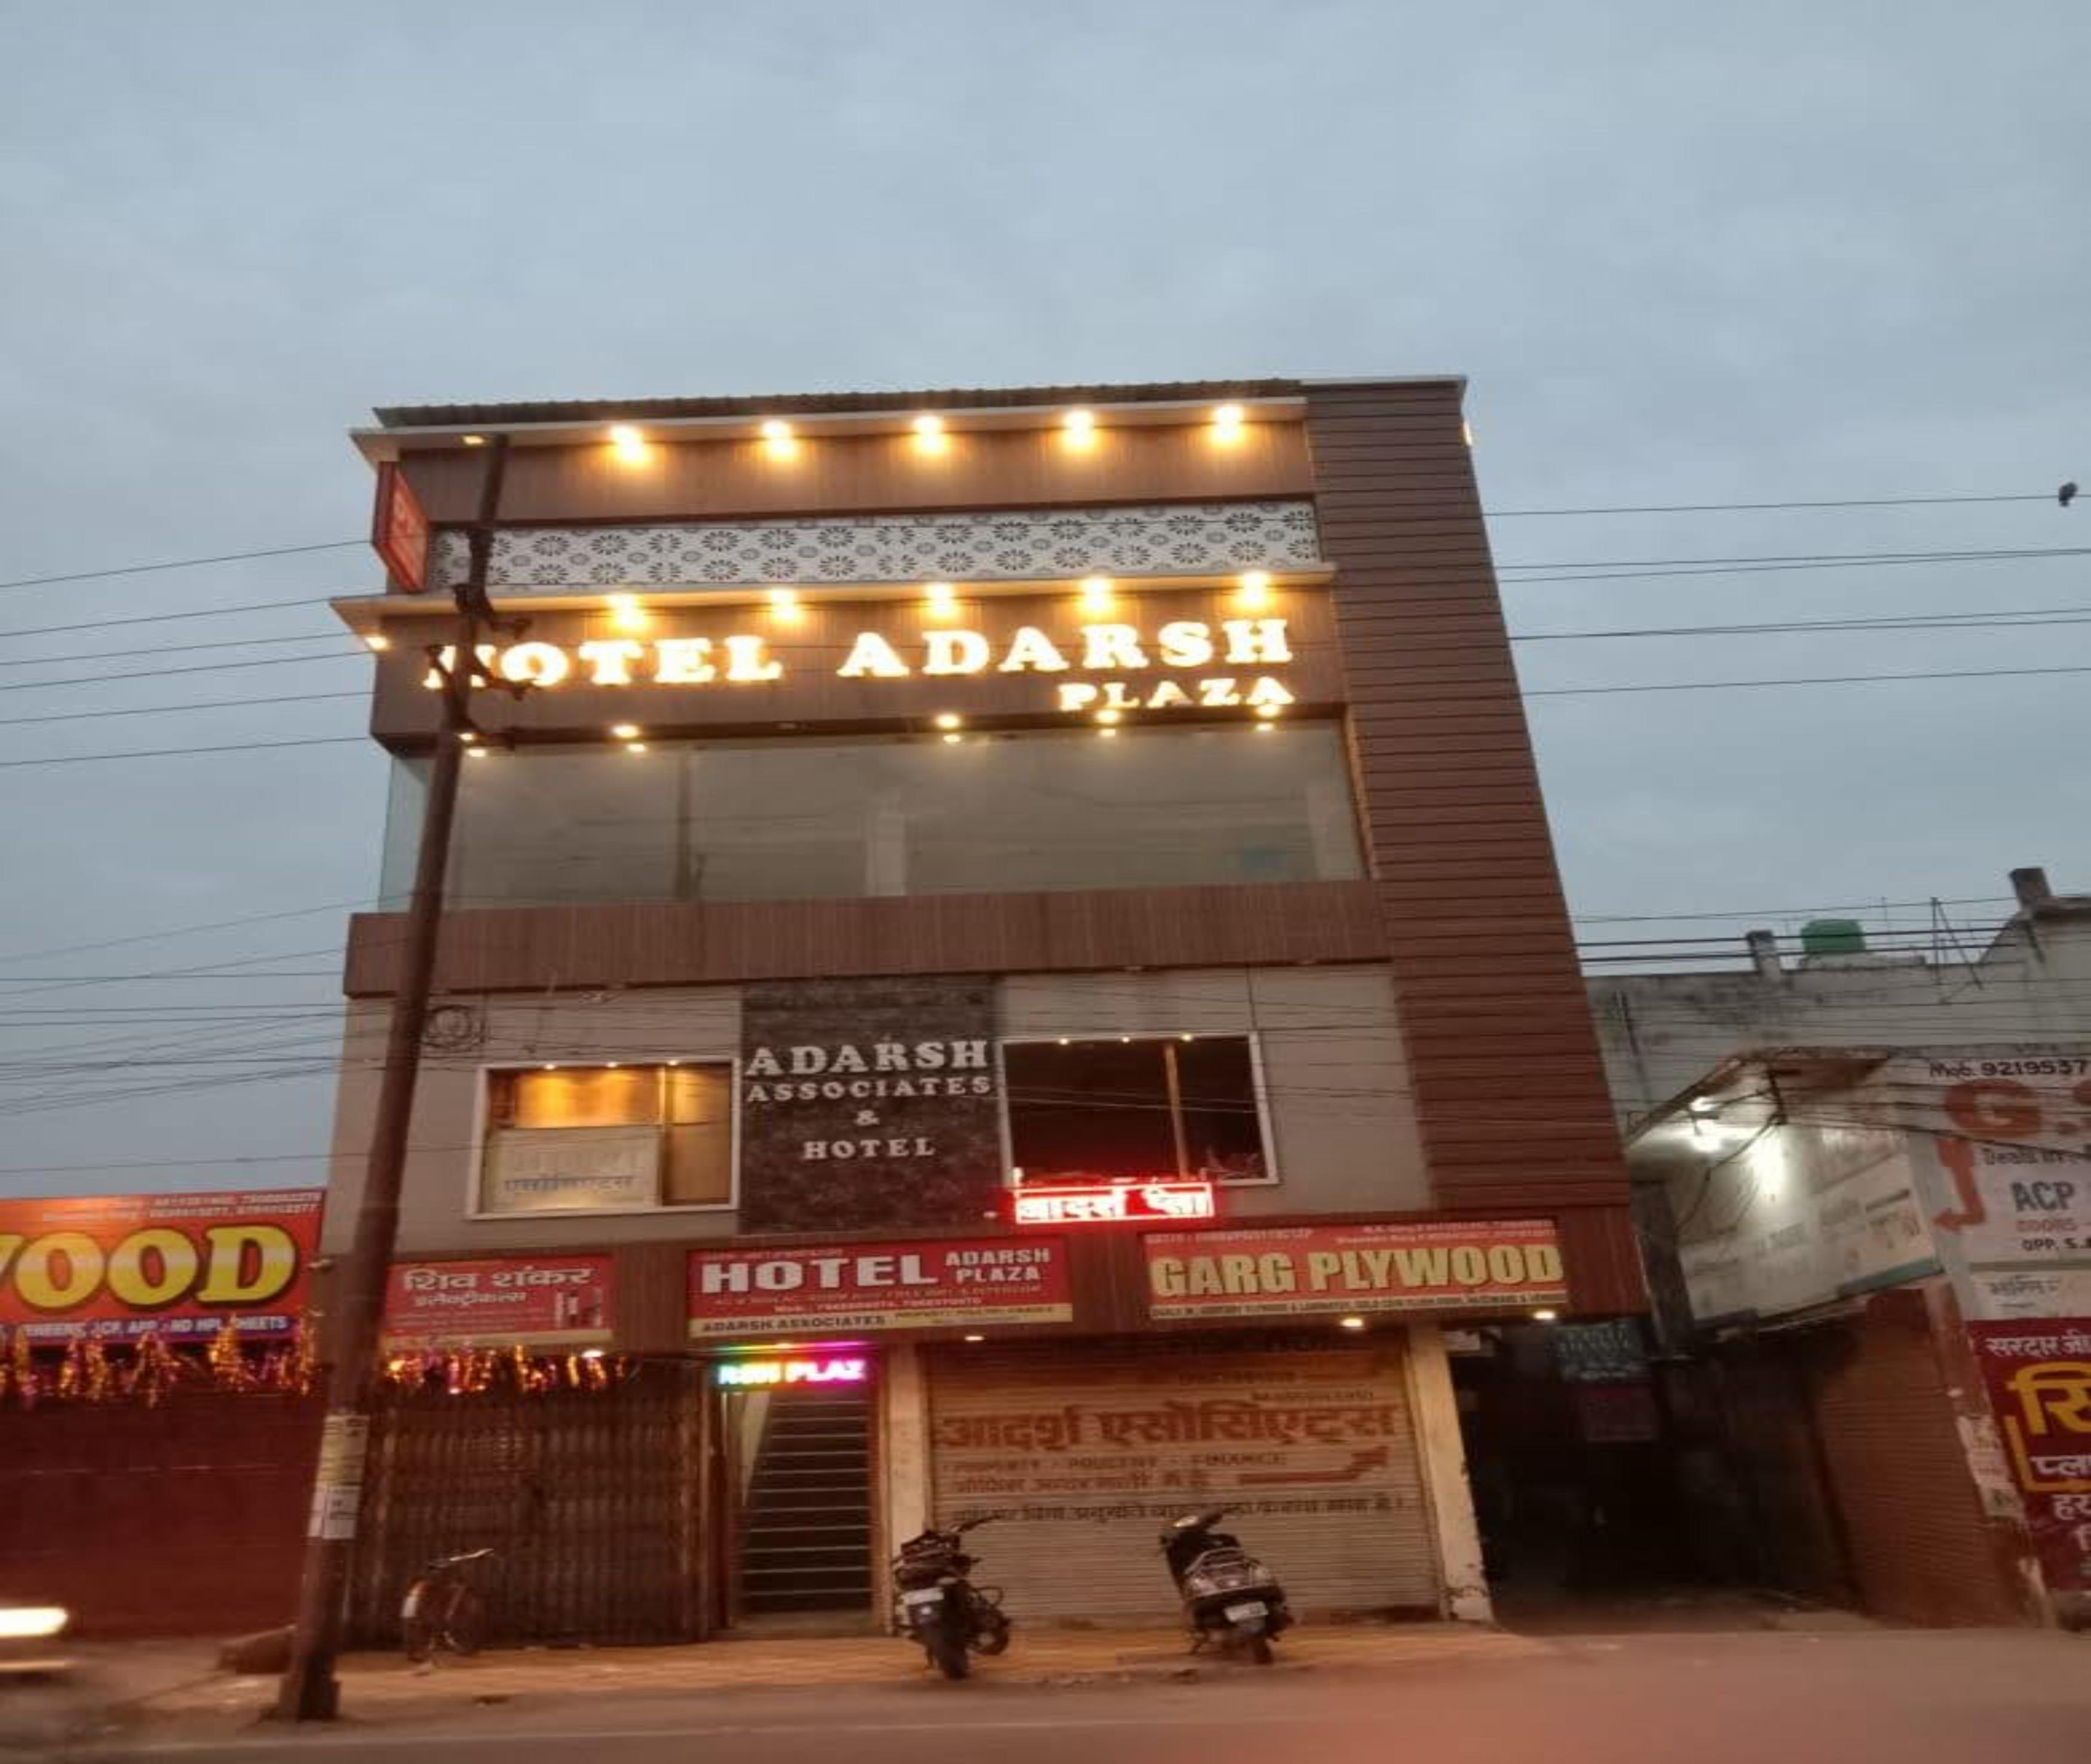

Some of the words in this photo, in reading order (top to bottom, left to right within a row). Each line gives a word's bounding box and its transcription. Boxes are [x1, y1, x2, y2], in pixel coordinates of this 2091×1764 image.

[836, 618, 1294, 677] ADARSH
[1058, 677, 1296, 712] PLAZA
[745, 1039, 988, 1077] ADARSH
[746, 1076, 992, 1103] ASSOCIATES
[854, 1109, 880, 1127] &
[802, 1138, 936, 1161] HOTEL
[2010, 1181, 2076, 1212] ACP
[403, 1268, 477, 1292] शिव
[492, 1265, 595, 1287] शंकर
[701, 1254, 940, 1294] HOTEL
[945, 1247, 1051, 1267] ADARSH
[956, 1265, 1041, 1283] PLAZA
[1151, 1252, 1295, 1297] GARG
[1307, 1244, 1566, 1293] PLYWOOD
[701, 1319, 774, 1333] ADARSH
[776, 1315, 886, 1330] ASSOCIATES
[940, 1404, 1085, 1450] आदर्श
